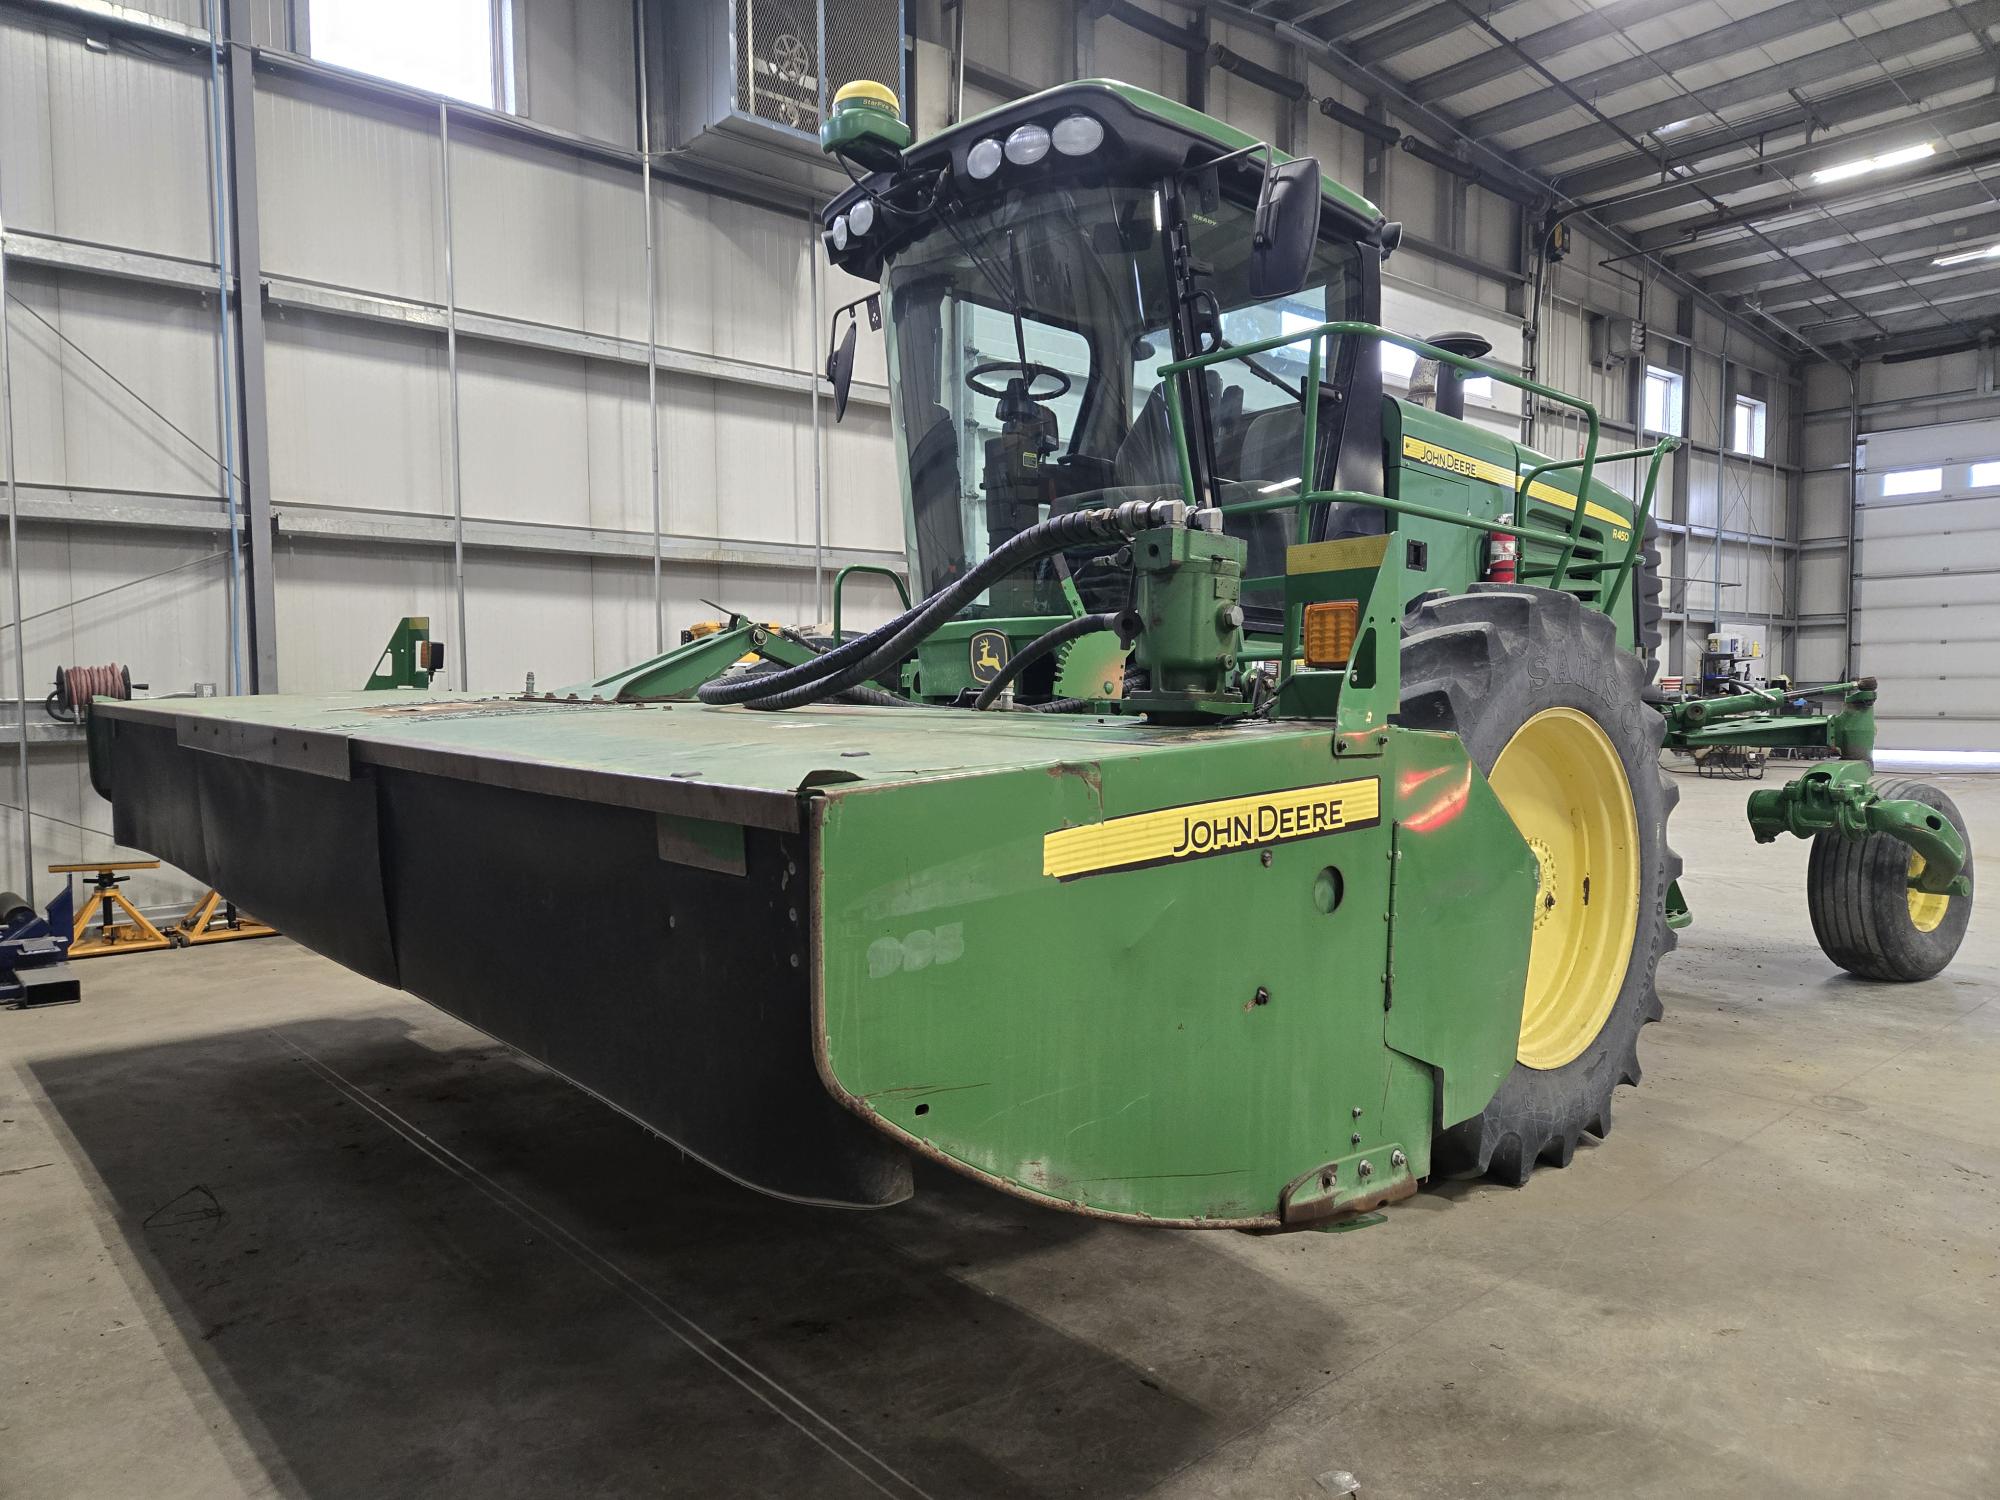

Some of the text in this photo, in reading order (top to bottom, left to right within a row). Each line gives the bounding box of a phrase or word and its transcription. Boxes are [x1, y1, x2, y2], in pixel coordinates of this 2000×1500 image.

[1420, 446, 1476, 475] JOHN DEERE
[1612, 528, 1629, 542] R450
[1174, 800, 1344, 853] JOHN DEERE
